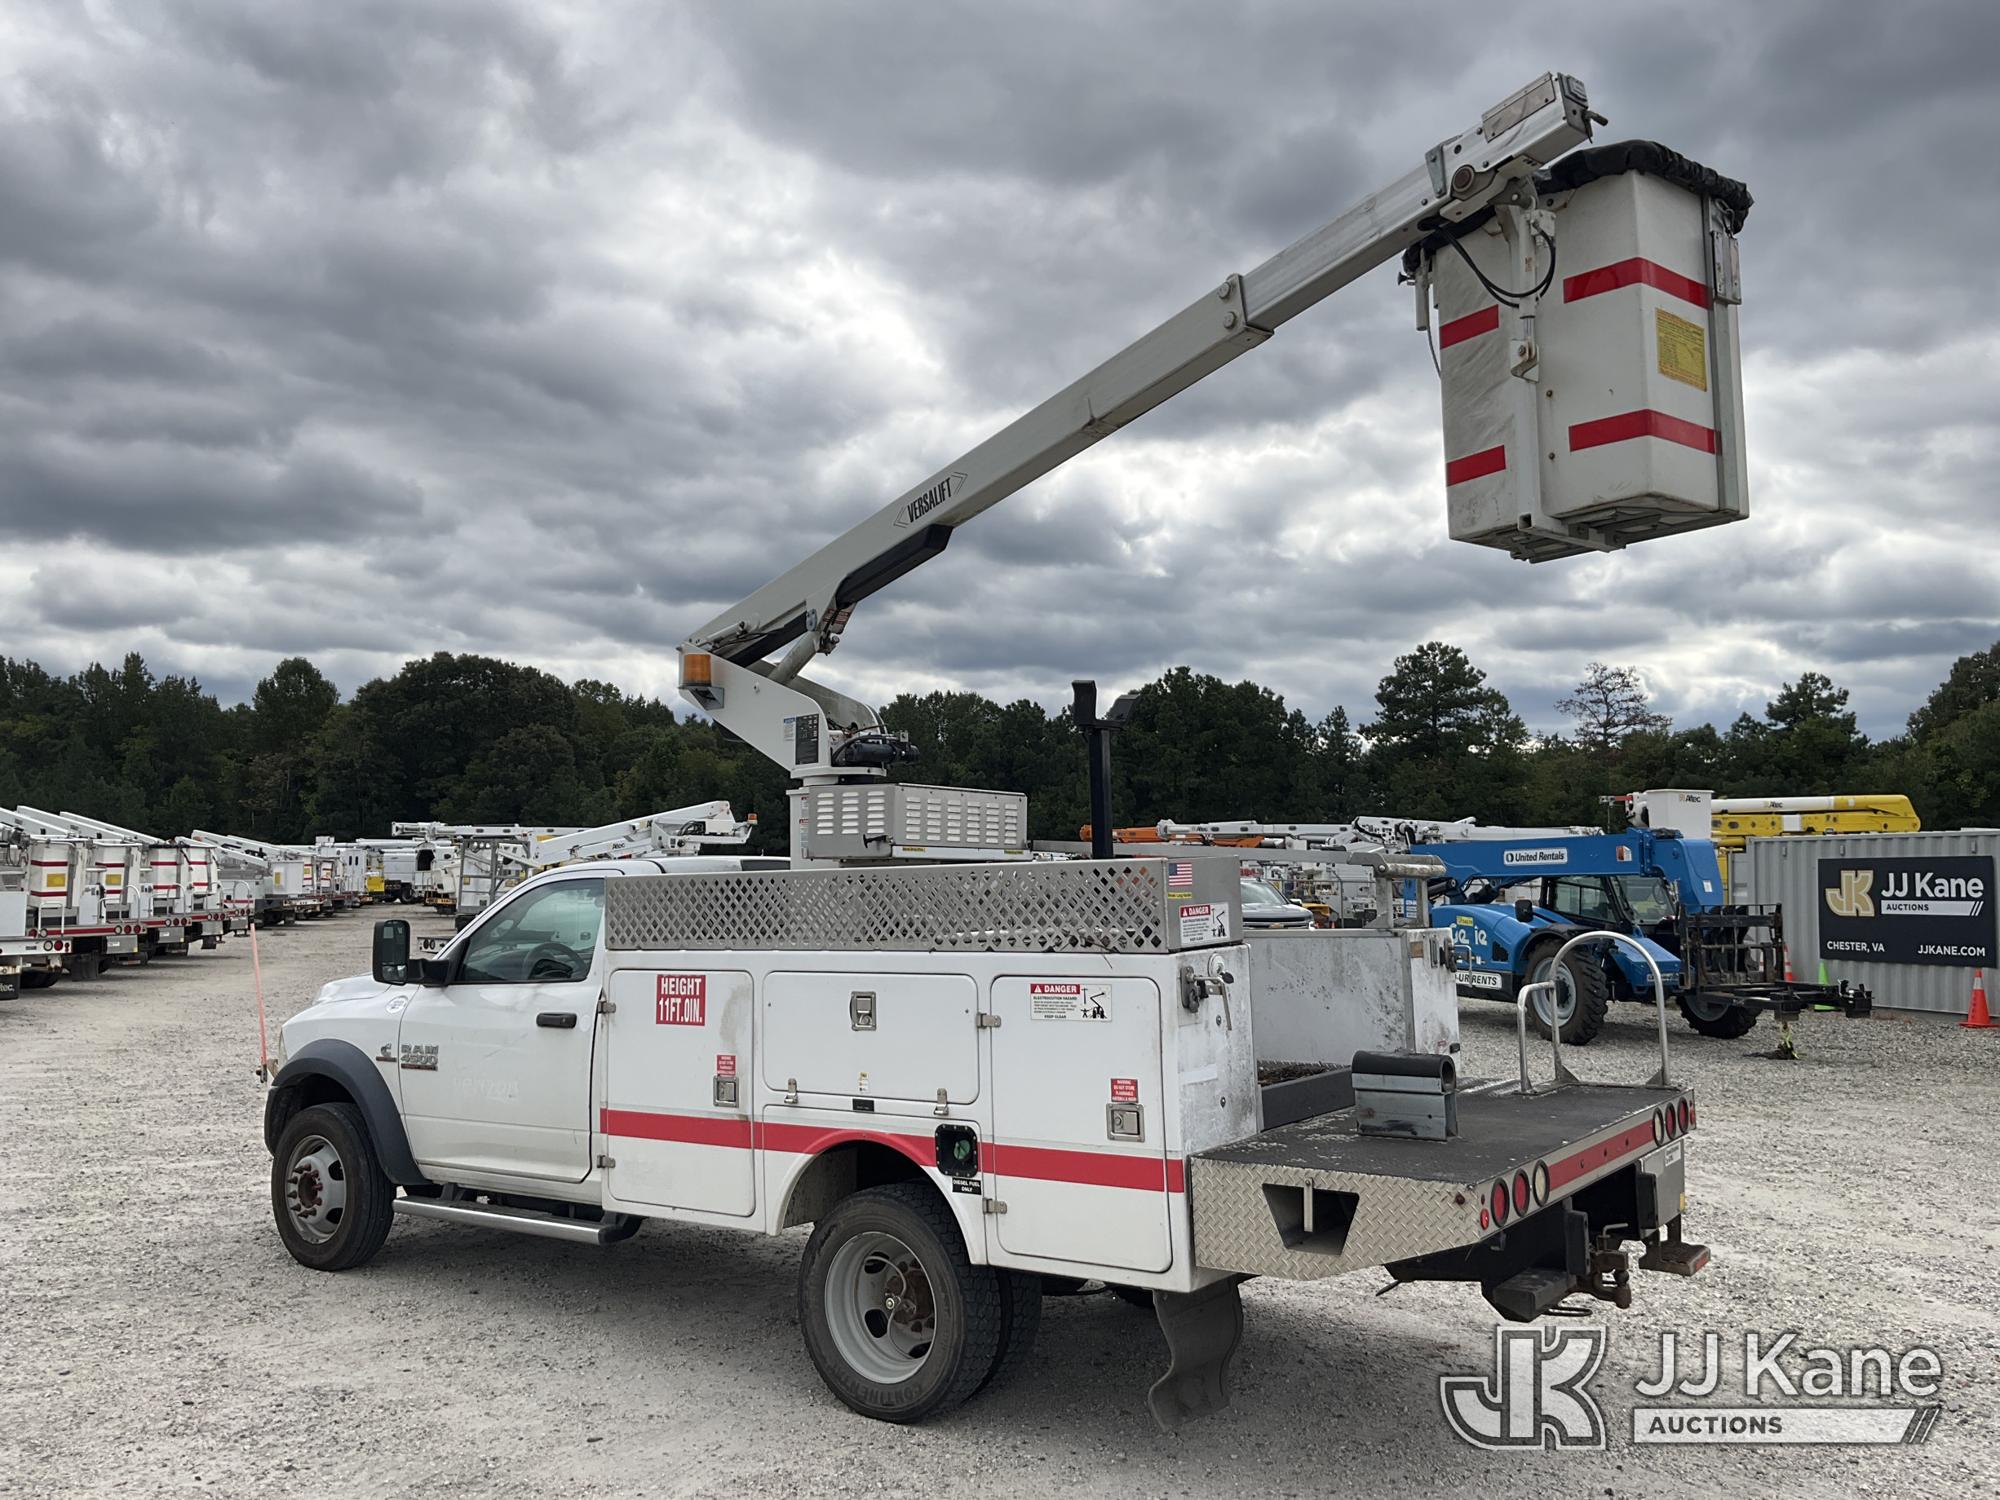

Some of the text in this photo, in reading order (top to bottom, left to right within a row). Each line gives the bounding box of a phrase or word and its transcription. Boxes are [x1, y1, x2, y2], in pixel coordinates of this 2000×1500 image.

[907, 477, 951, 522] VERSALIFT
[1515, 851, 1564, 862] United Rentals
[1881, 872, 1984, 898] JJ Kane
[1188, 907, 1209, 916] DANGER
[1827, 940, 1885, 953] CHESTER, VA
[1917, 944, 1986, 957] JJKANE.COM
[661, 977, 702, 996] HEIGHT
[1471, 975, 1497, 986] RENTS
[1044, 985, 1077, 993] DANGER
[401, 1044, 439, 1055] RAM
